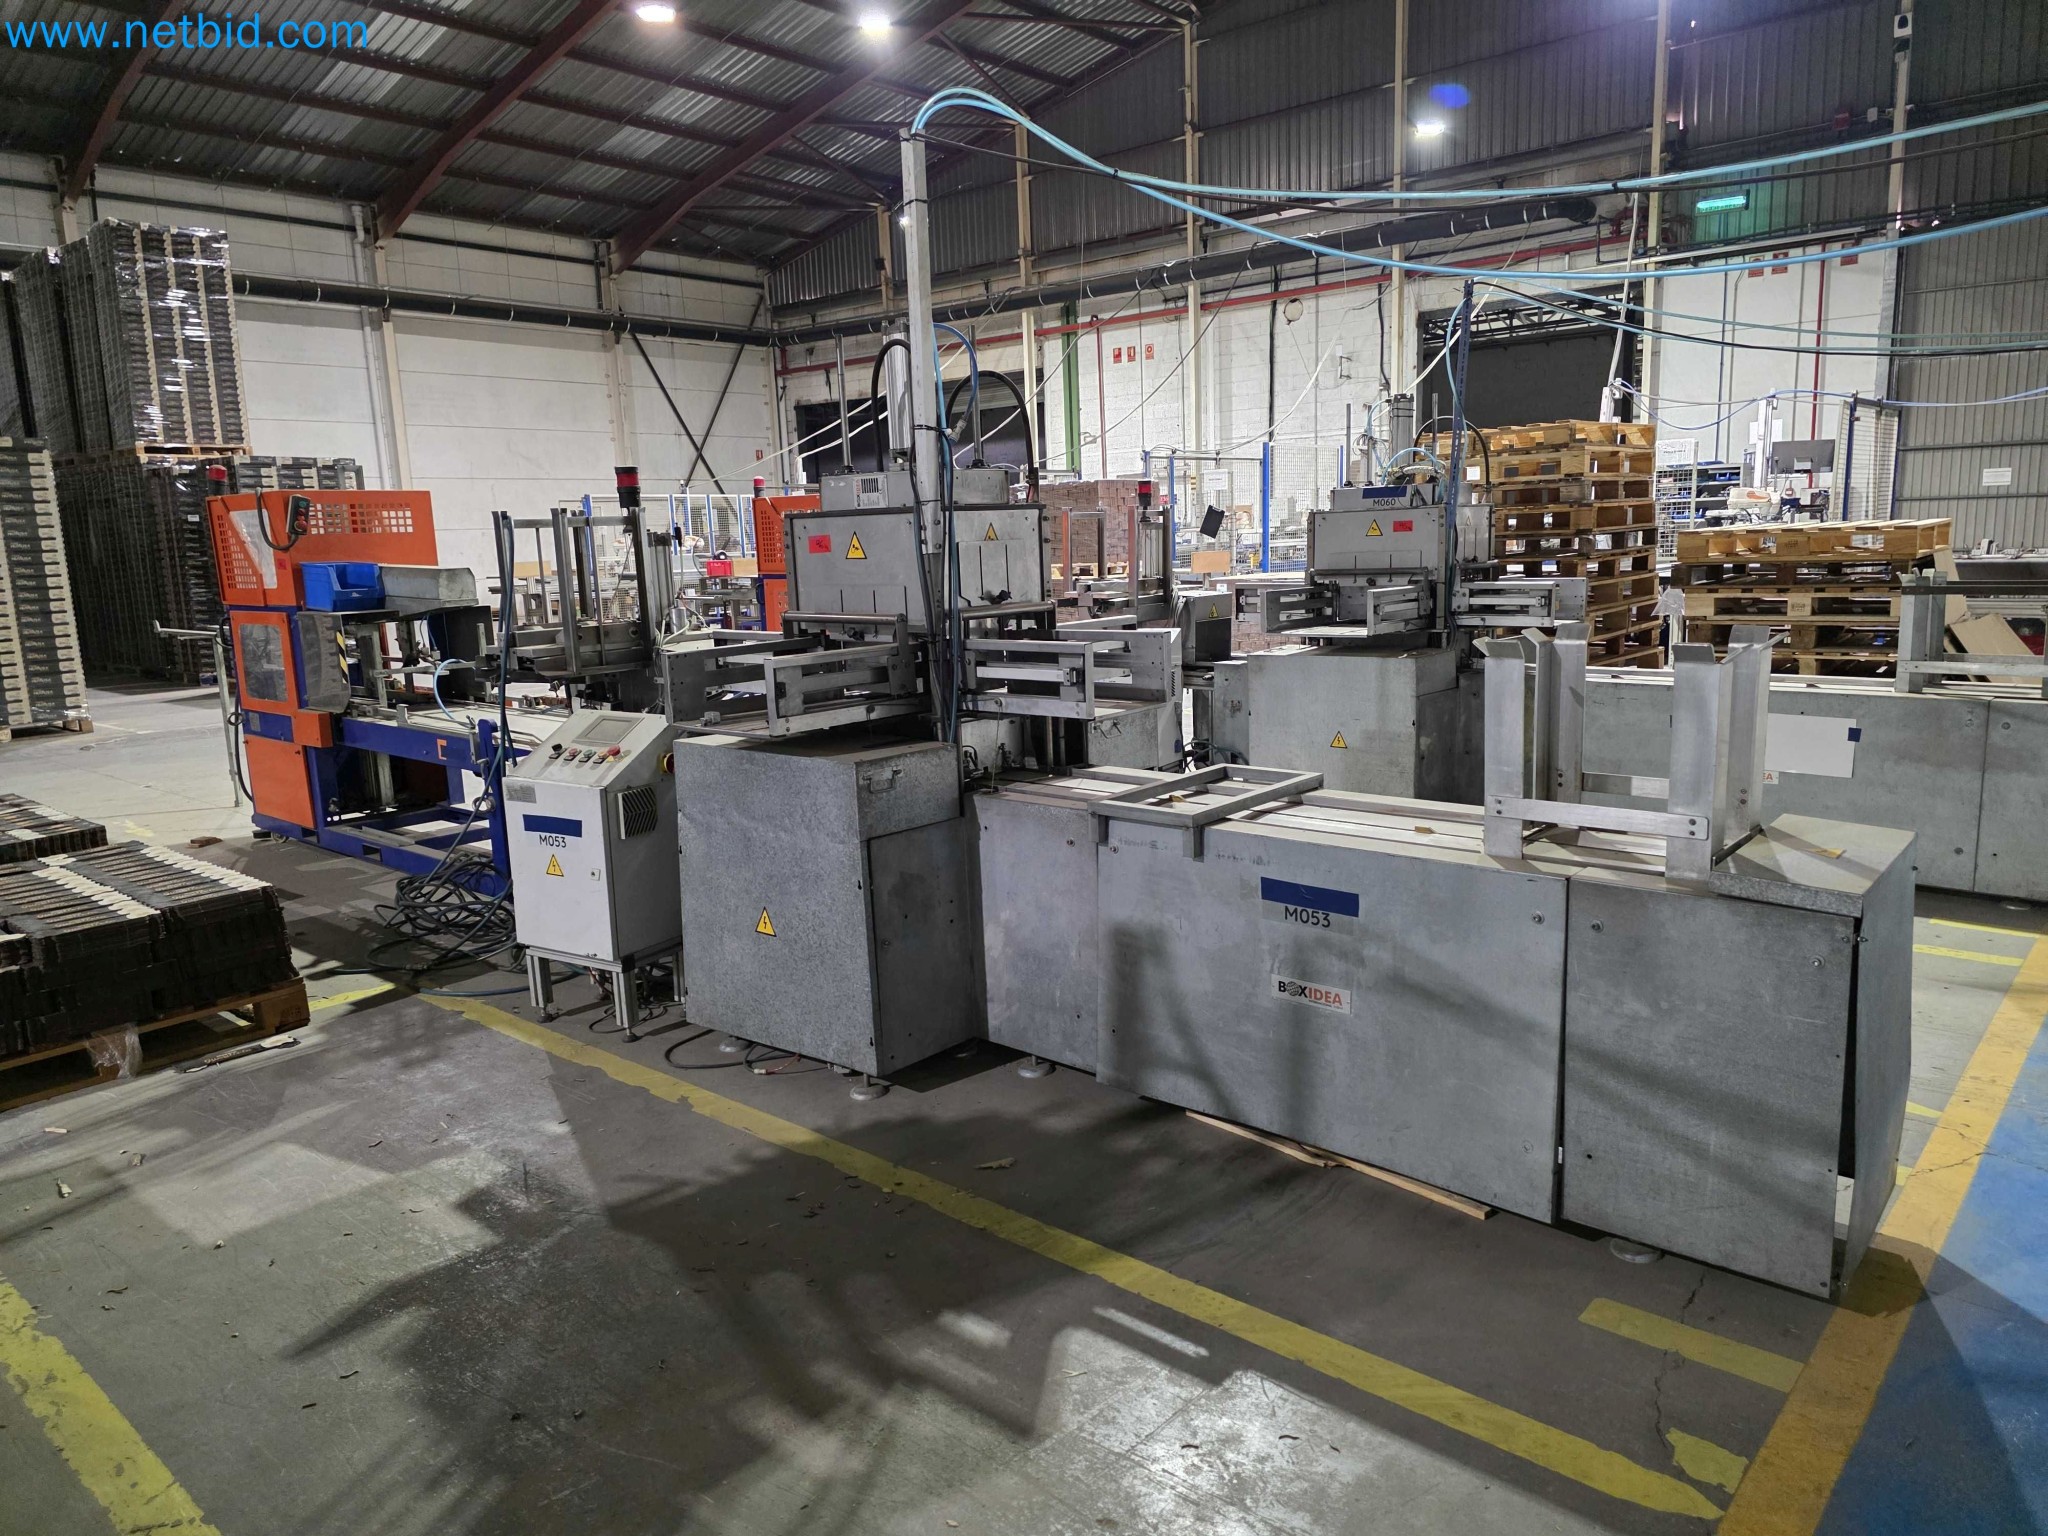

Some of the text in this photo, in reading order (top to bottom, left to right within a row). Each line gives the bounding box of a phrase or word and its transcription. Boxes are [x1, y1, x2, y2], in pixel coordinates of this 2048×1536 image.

[1372, 498, 1396, 507] M060
[539, 834, 567, 849] M053
[1284, 905, 1331, 928] M053
[1278, 980, 1343, 1006] BOXIDEA
